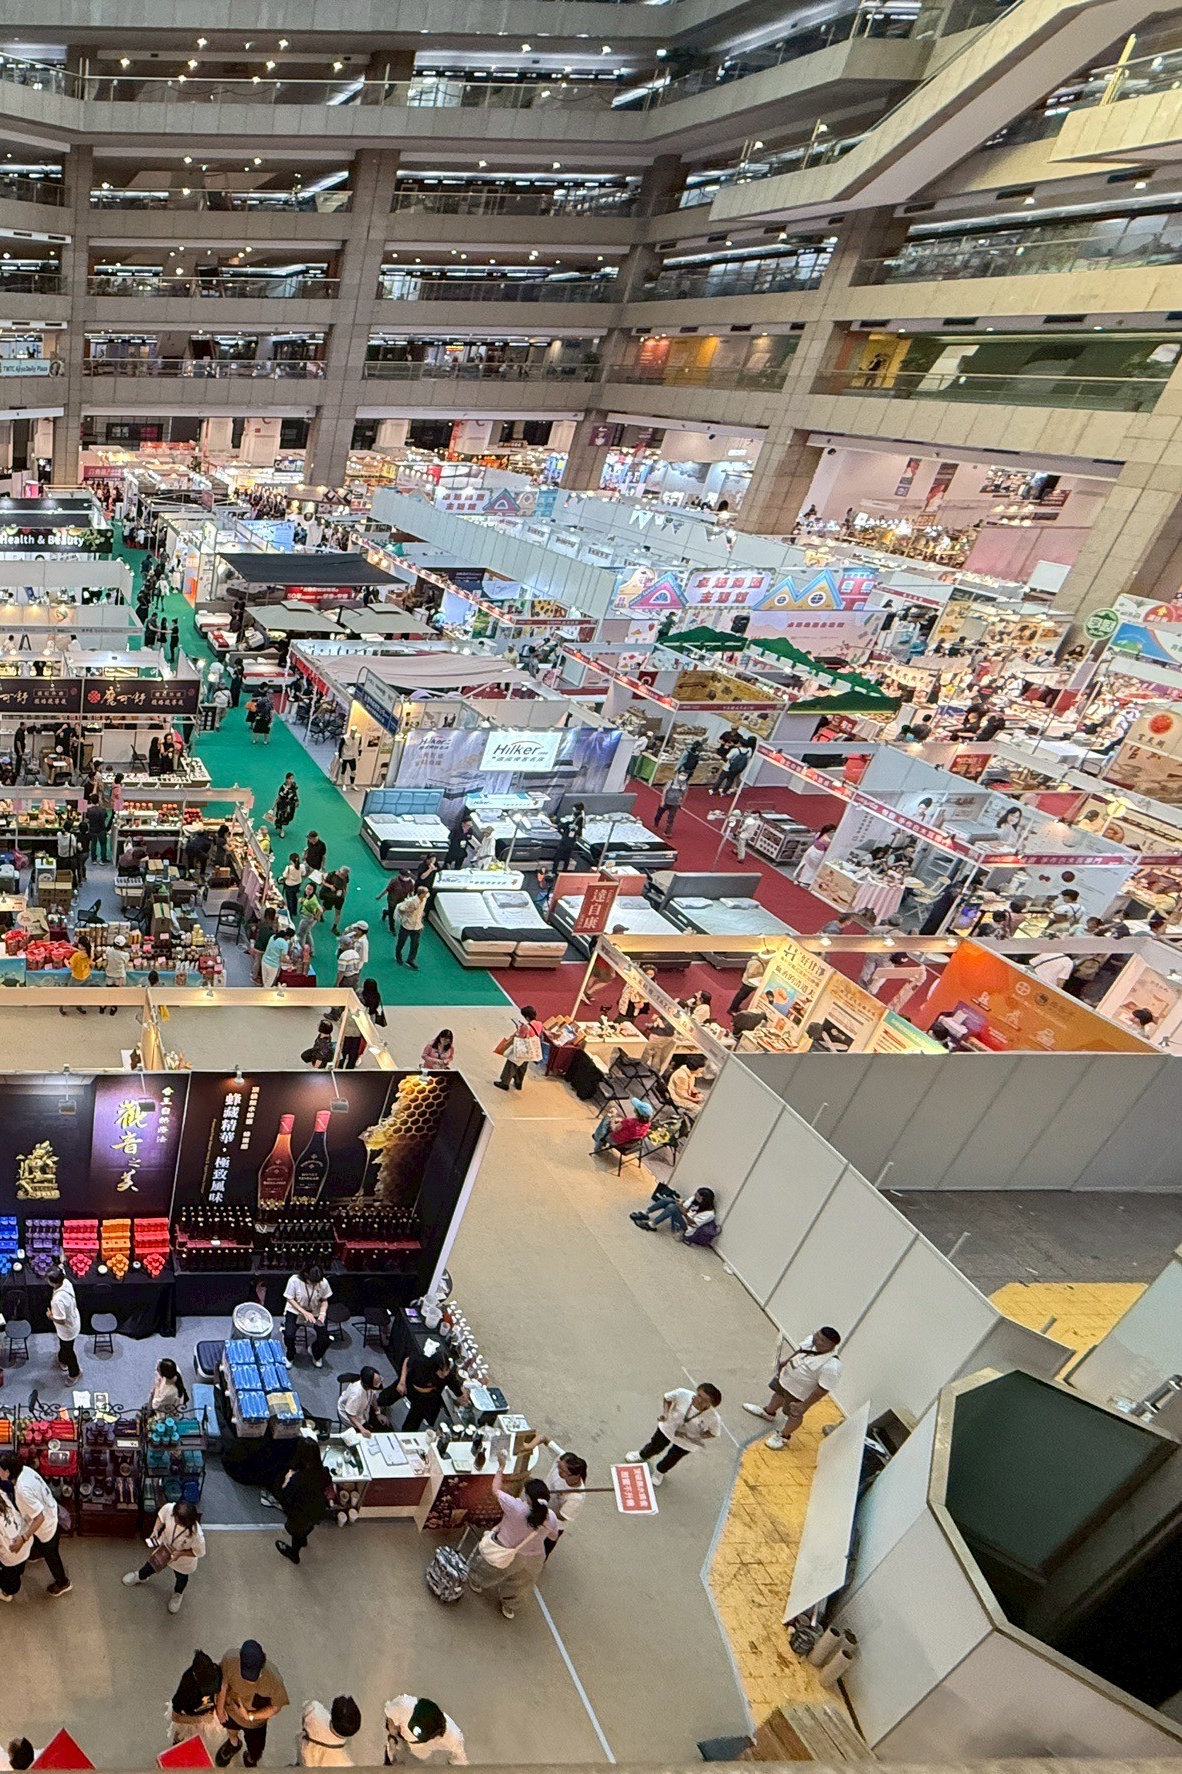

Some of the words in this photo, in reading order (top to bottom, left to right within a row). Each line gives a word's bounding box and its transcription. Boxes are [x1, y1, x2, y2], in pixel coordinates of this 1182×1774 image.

[47, 534, 85, 548] Beauty
[492, 743, 542, 755] Hilker
[110, 1099, 148, 1193] 觀音之美
